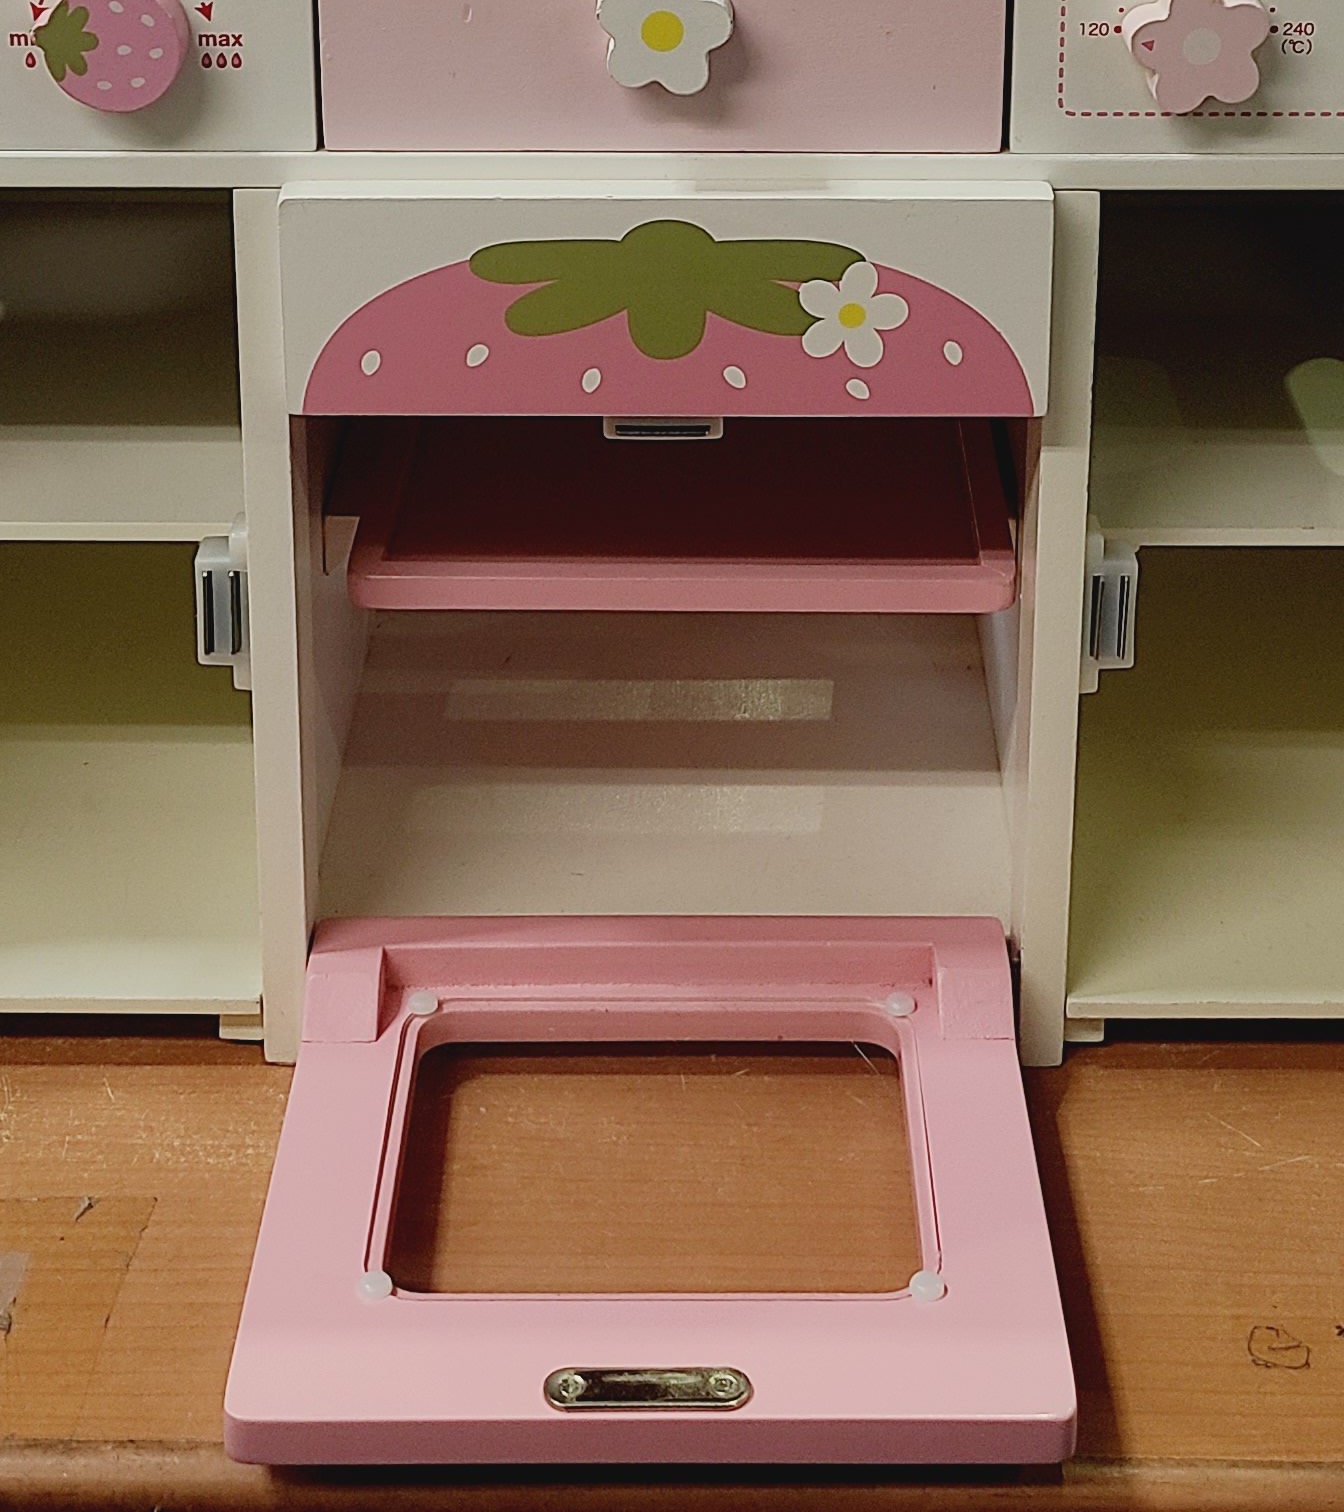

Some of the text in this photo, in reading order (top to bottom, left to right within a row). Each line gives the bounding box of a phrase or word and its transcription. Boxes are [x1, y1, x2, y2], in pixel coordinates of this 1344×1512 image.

[1079, 22, 1110, 36] 120
[1282, 22, 1315, 36] 240
[197, 33, 243, 48] max
